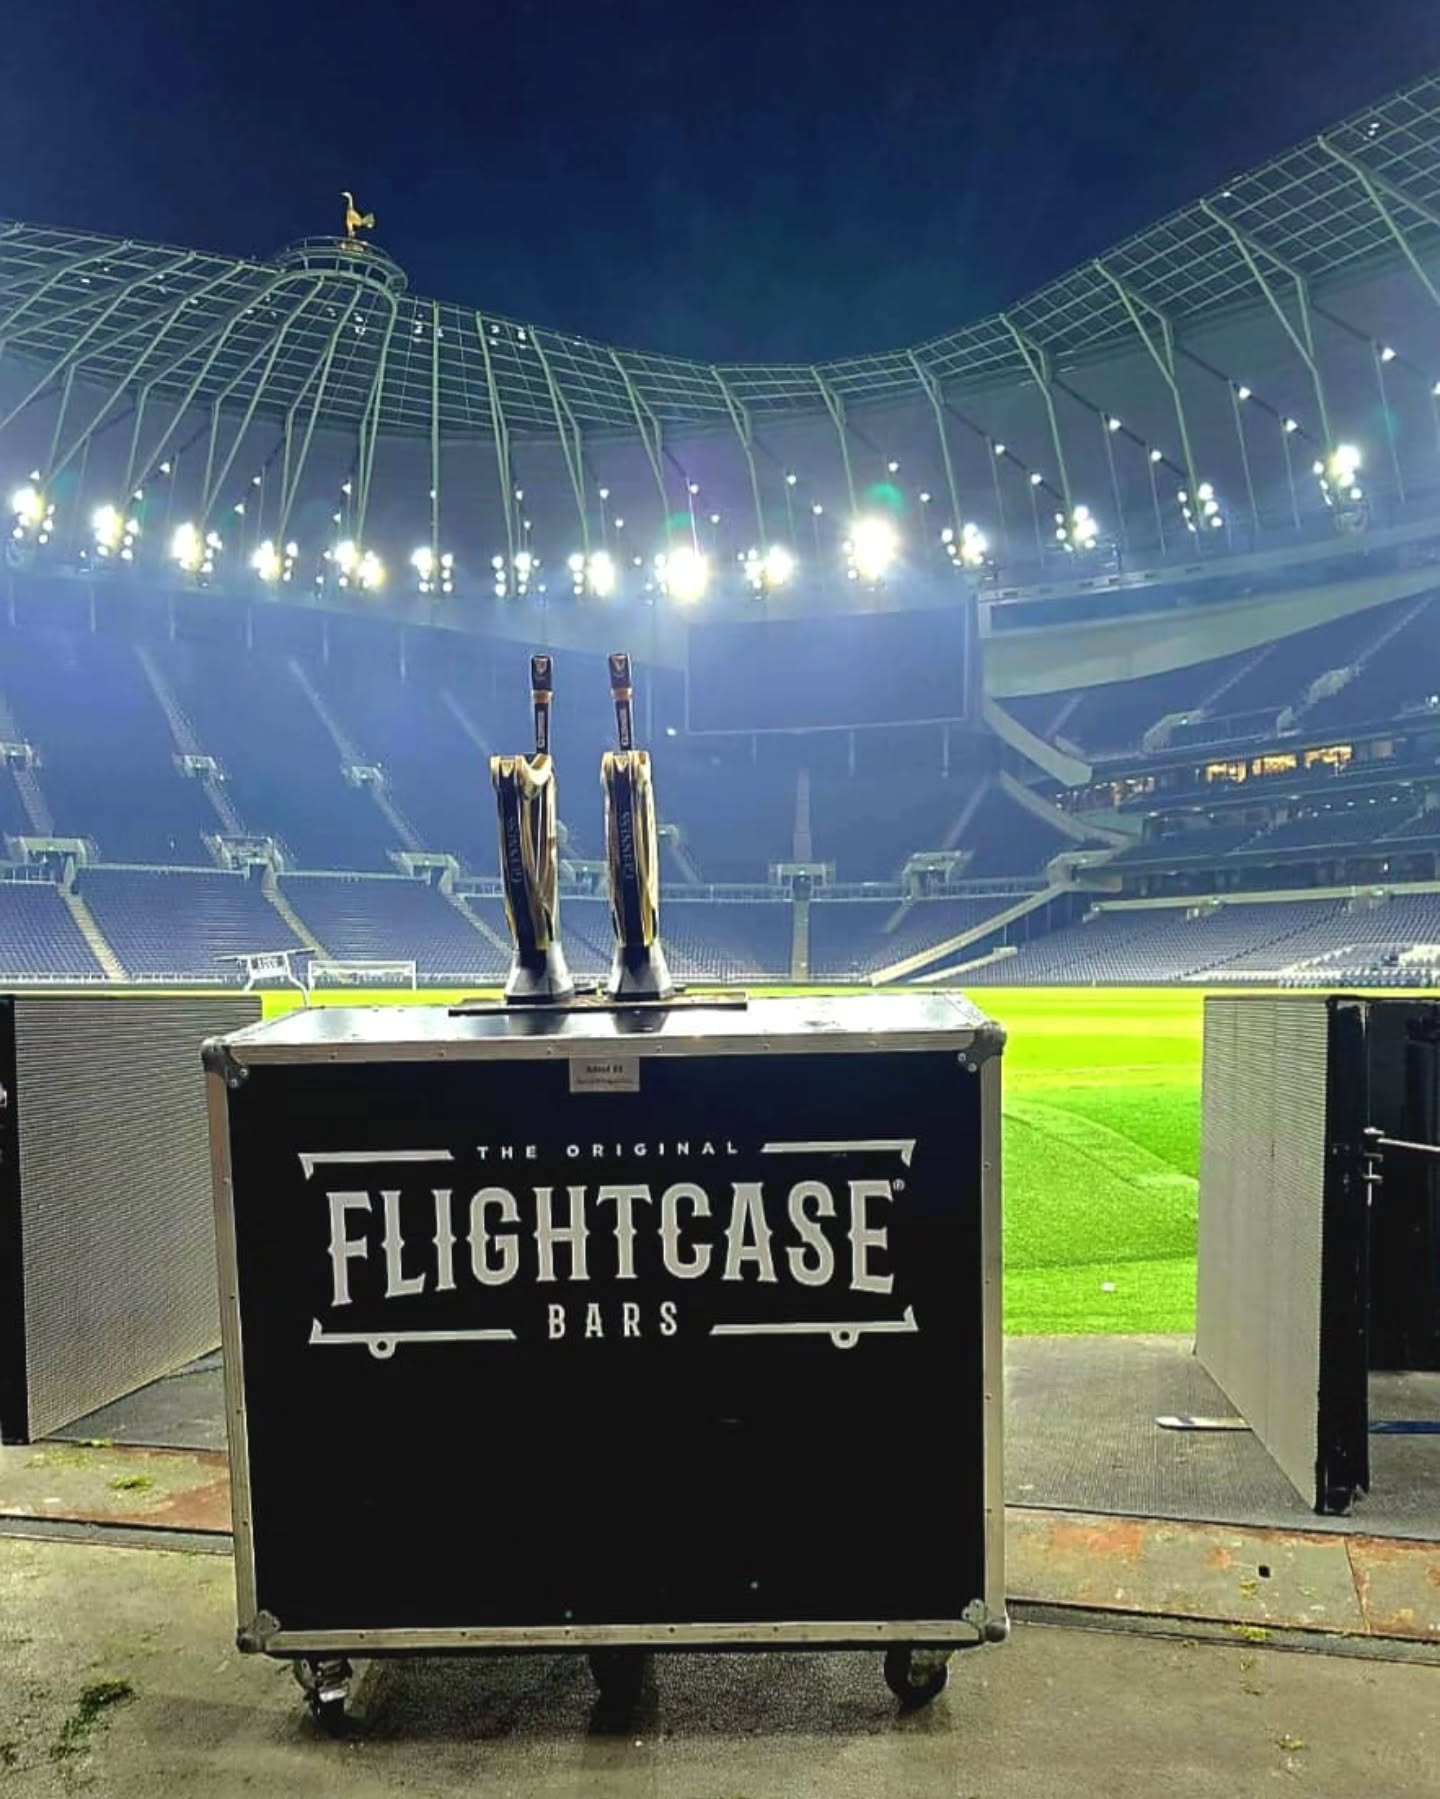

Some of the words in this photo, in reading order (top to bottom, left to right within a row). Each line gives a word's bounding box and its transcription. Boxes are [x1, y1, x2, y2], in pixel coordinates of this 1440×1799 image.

[477, 1145, 537, 1160] THE
[566, 1141, 738, 1158] ORIGINAL
[548, 1301, 678, 1339] BARS
